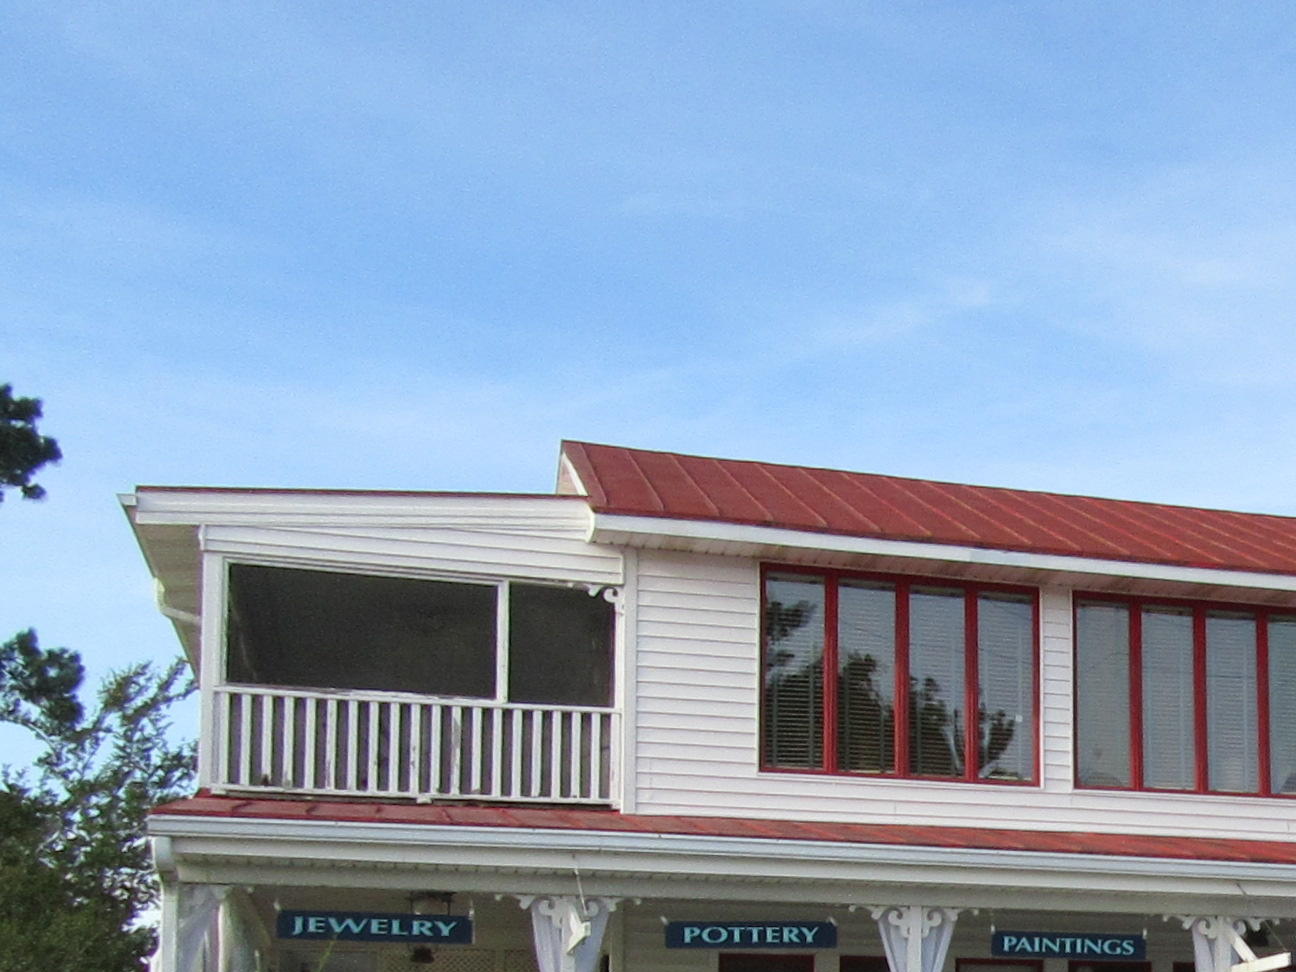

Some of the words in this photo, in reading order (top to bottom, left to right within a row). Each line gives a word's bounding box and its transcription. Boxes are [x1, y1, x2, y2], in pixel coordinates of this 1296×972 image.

[292, 916, 457, 937] JEWELRY
[683, 926, 819, 943] POTTERY
[1003, 935, 1135, 955] PAINTINGS
